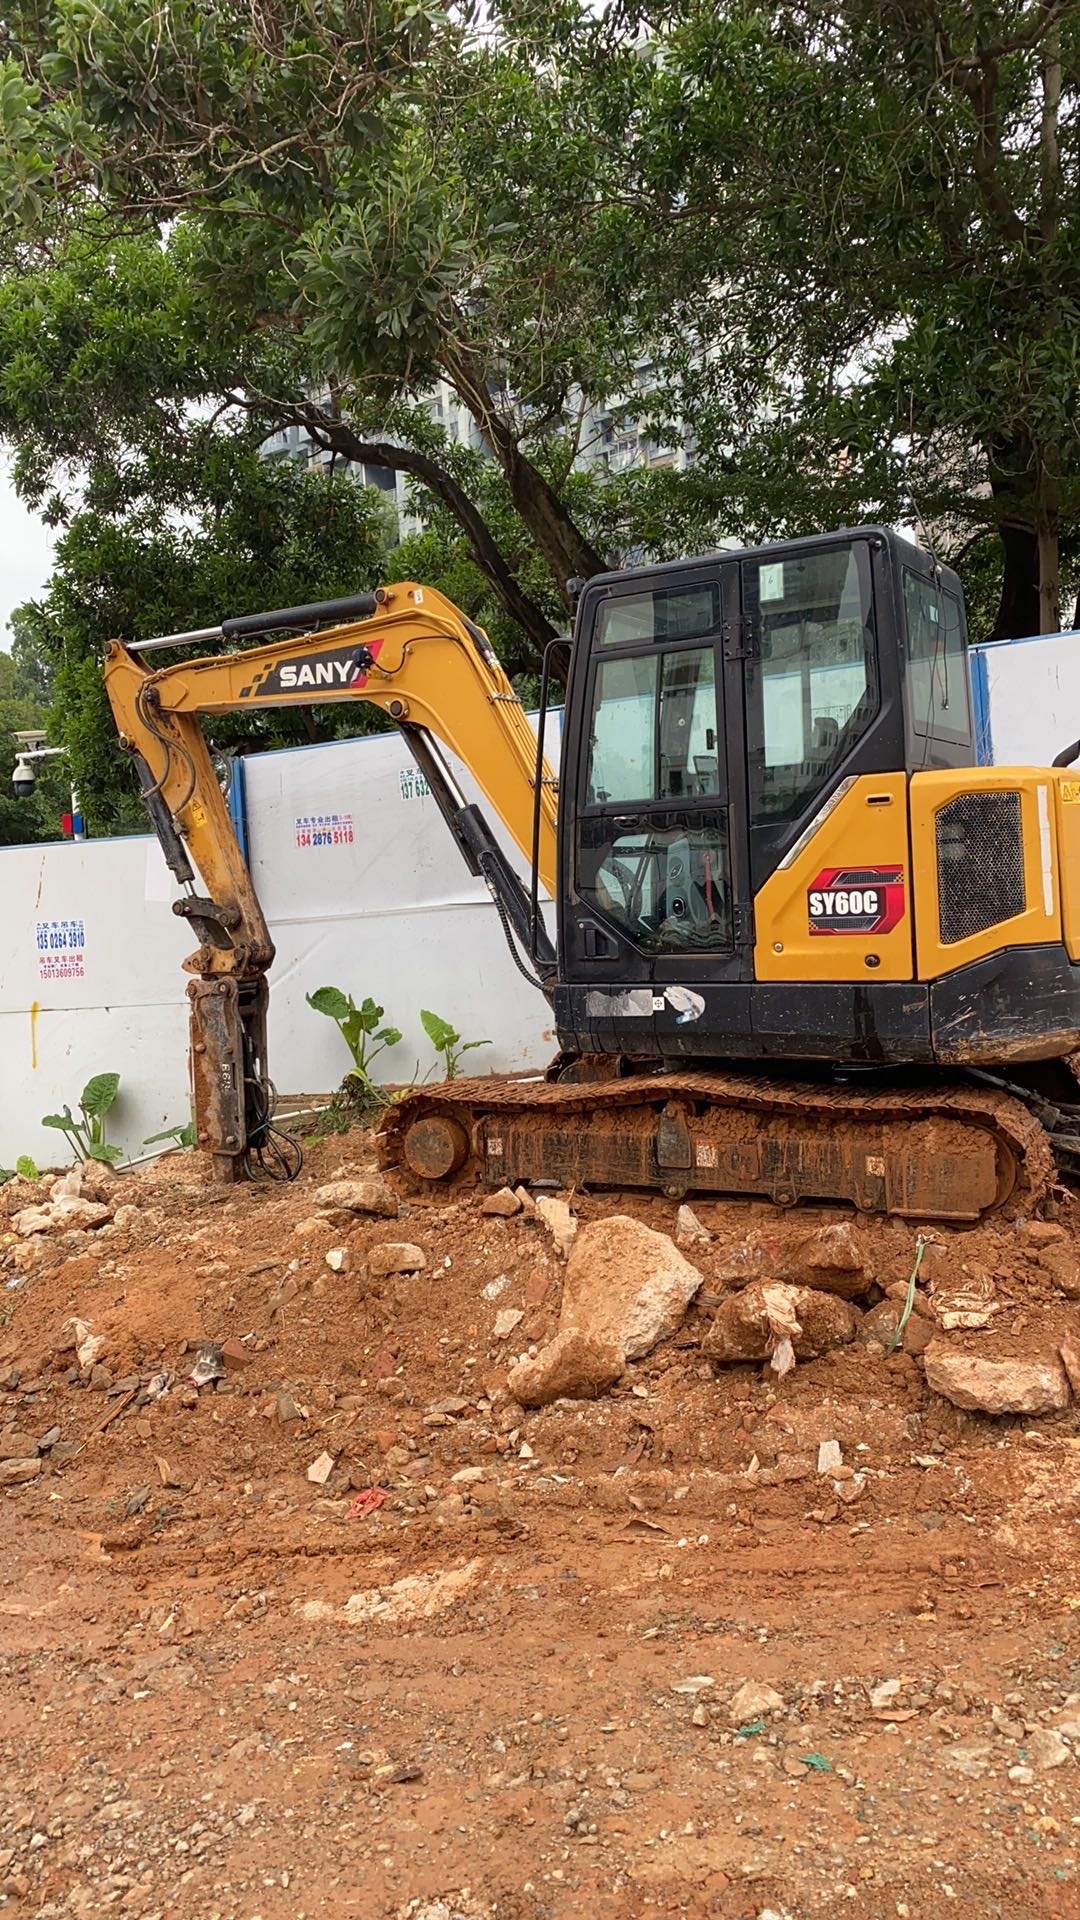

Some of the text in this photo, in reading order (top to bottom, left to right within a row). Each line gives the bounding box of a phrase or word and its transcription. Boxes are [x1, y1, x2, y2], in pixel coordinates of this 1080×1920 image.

[280, 660, 354, 688] SANY
[296, 831, 354, 847] 134 2876 5118
[809, 890, 878, 916] SY60C
[36, 931, 85, 950] 135 0264 3910
